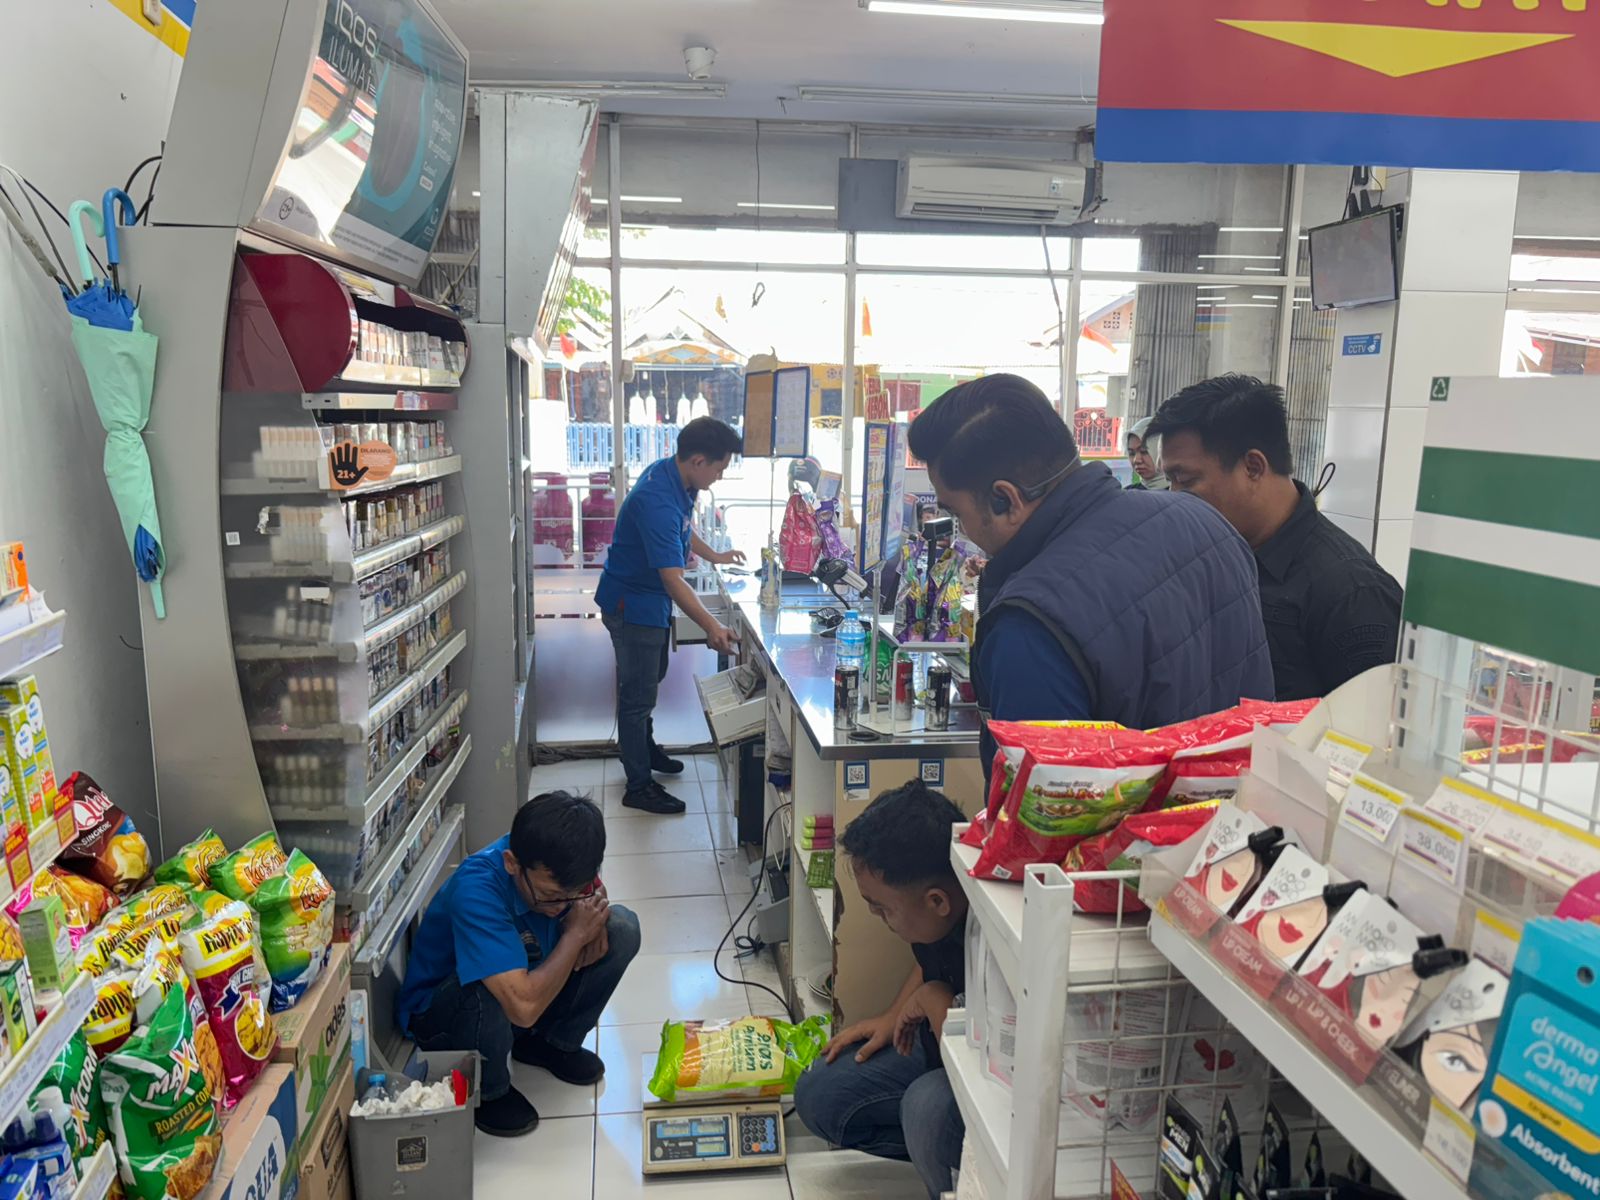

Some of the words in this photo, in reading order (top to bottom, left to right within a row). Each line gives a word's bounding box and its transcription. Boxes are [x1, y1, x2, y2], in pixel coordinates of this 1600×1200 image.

[335, 0, 378, 58] IQOS
[328, 35, 366, 92] ILUMA
[1348, 344, 1366, 354] CCTV
[336, 470, 356, 479] 21+
[1416, 831, 1456, 864] 38.000
[201, 922, 246, 954] Happy
[1222, 935, 1236, 950] LIP
[1233, 944, 1263, 975] CREAM
[325, 997, 346, 1048] ades
[1307, 1002, 1323, 1019] LIP
[1328, 1025, 1360, 1061] CHEEK
[1531, 1016, 1600, 1065] derma
[155, 1103, 195, 1135] ROASTED
[1169, 1128, 1190, 1153] MEN
[1510, 1123, 1600, 1196] Absorbent
